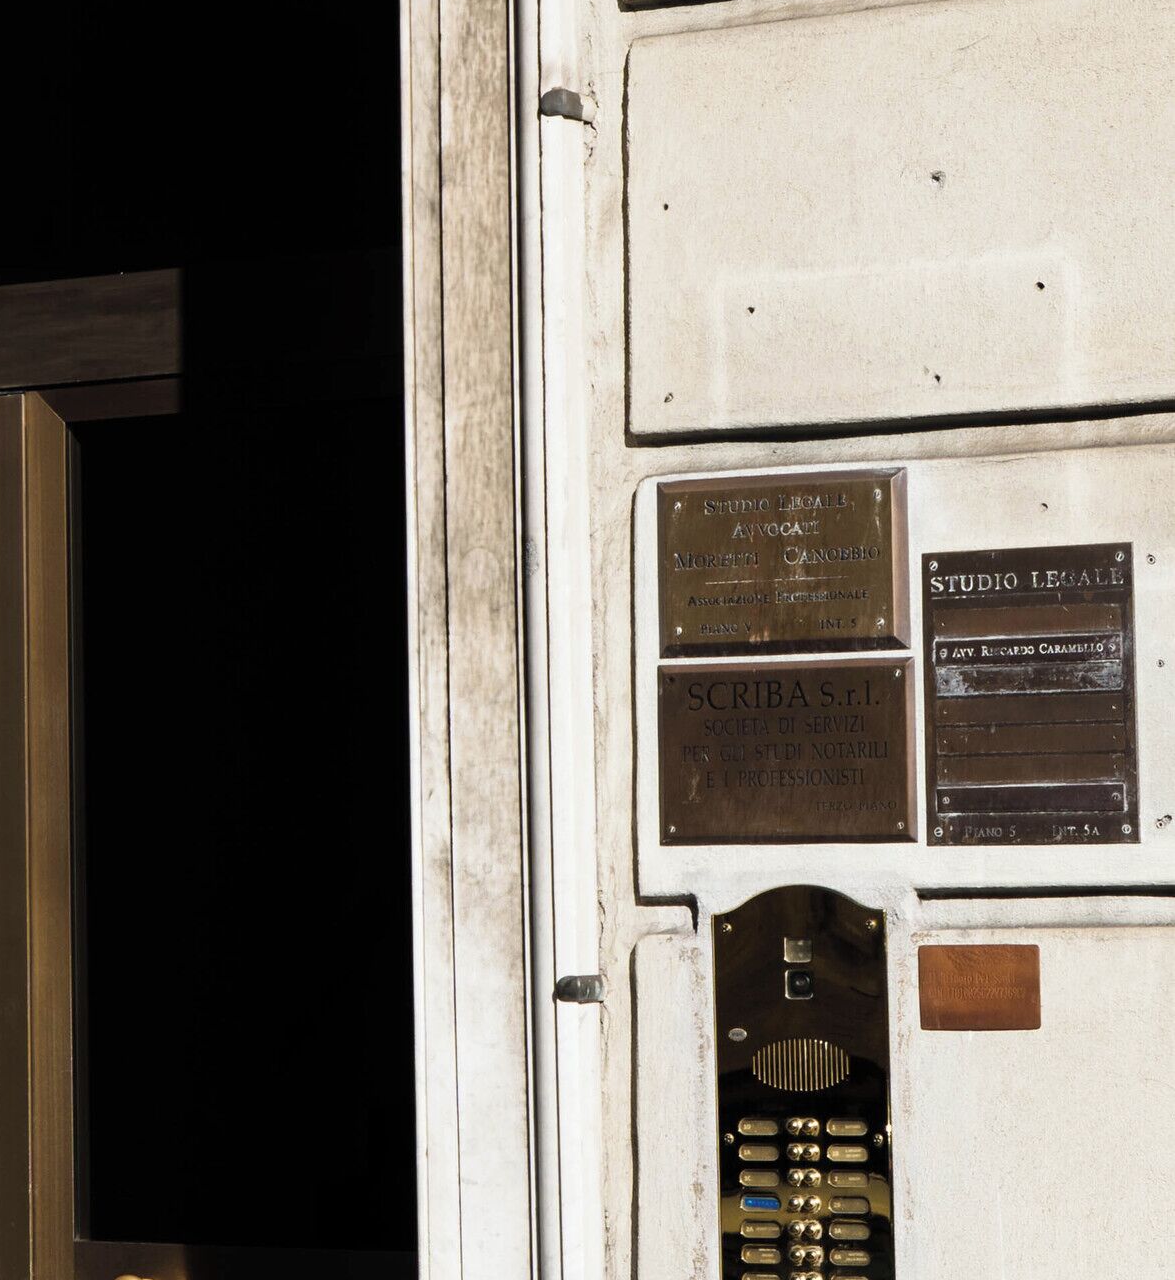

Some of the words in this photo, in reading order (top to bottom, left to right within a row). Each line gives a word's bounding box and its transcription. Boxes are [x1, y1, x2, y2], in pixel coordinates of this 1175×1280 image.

[704, 497, 771, 516] STUDIO
[778, 493, 848, 511] LEGALE
[731, 520, 820, 539] AVVOCATI
[674, 551, 761, 571] MORETTI
[783, 545, 881, 565] CANOBBIO
[930, 572, 1018, 593] STUDIO
[1031, 567, 1124, 589] LEGALE
[981, 645, 1035, 657] RICARDO
[1039, 642, 1104, 655] CARAMELLO
[688, 680, 809, 711] SCRIBA
[820, 679, 880, 707] S.r.l.
[778, 717, 795, 734] DI
[805, 715, 865, 734] SERVIZI
[683, 744, 710, 763] PER
[720, 744, 744, 762] GLI
[755, 742, 802, 761] STUDI
[812, 741, 888, 761] NOTARILI
[706, 771, 715, 789] E
[738, 768, 864, 788] PROFESSIONISTI
[965, 826, 1003, 838] PIANO
